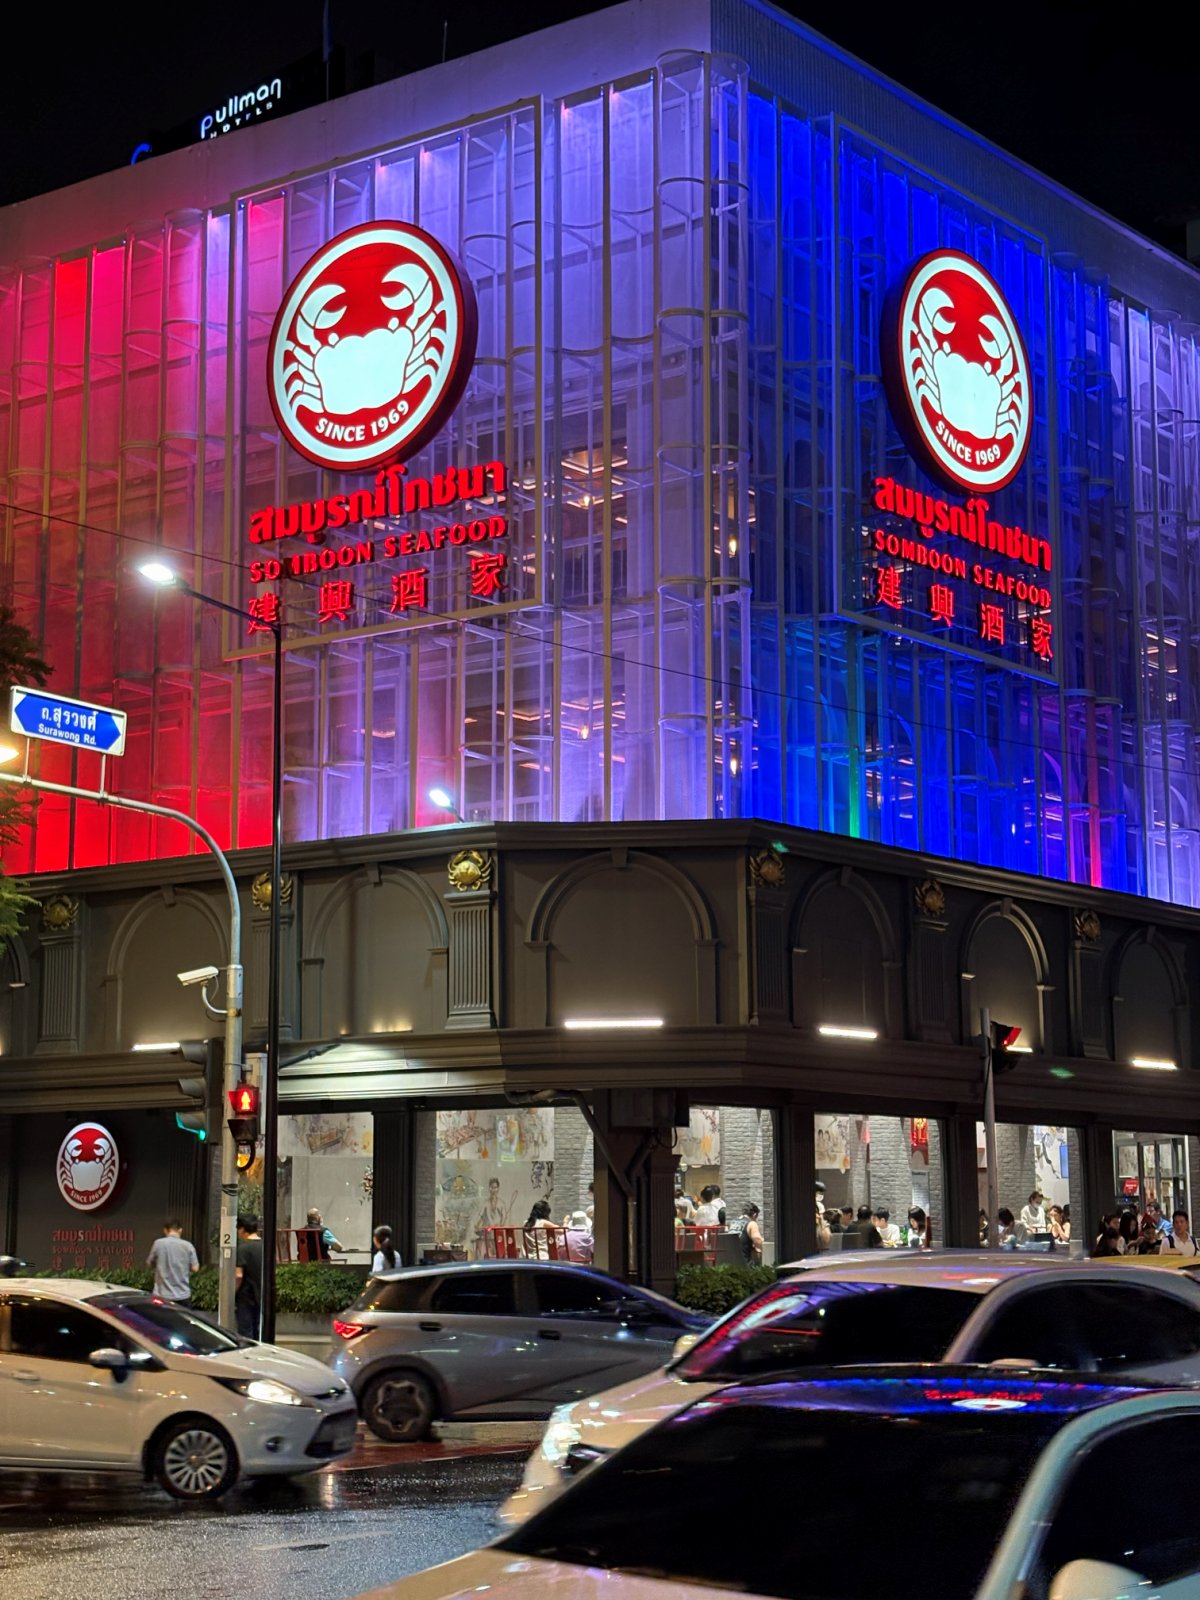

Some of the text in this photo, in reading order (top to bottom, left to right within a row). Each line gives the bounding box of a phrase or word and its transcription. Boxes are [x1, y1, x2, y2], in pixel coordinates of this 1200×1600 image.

[201, 79, 282, 139] pullman
[315, 400, 410, 442] SINCE 1969
[936, 421, 1001, 466] SINCE 1969
[384, 515, 507, 558] SEAFOOD
[875, 529, 1051, 609] SOMBOON SEAFOOD
[877, 566, 1053, 658] 建興酒家
[38, 723, 97, 745] Surawong Rd.
[70, 1190, 88, 1203] SINCE
[224, 1233, 231, 1244] 2
